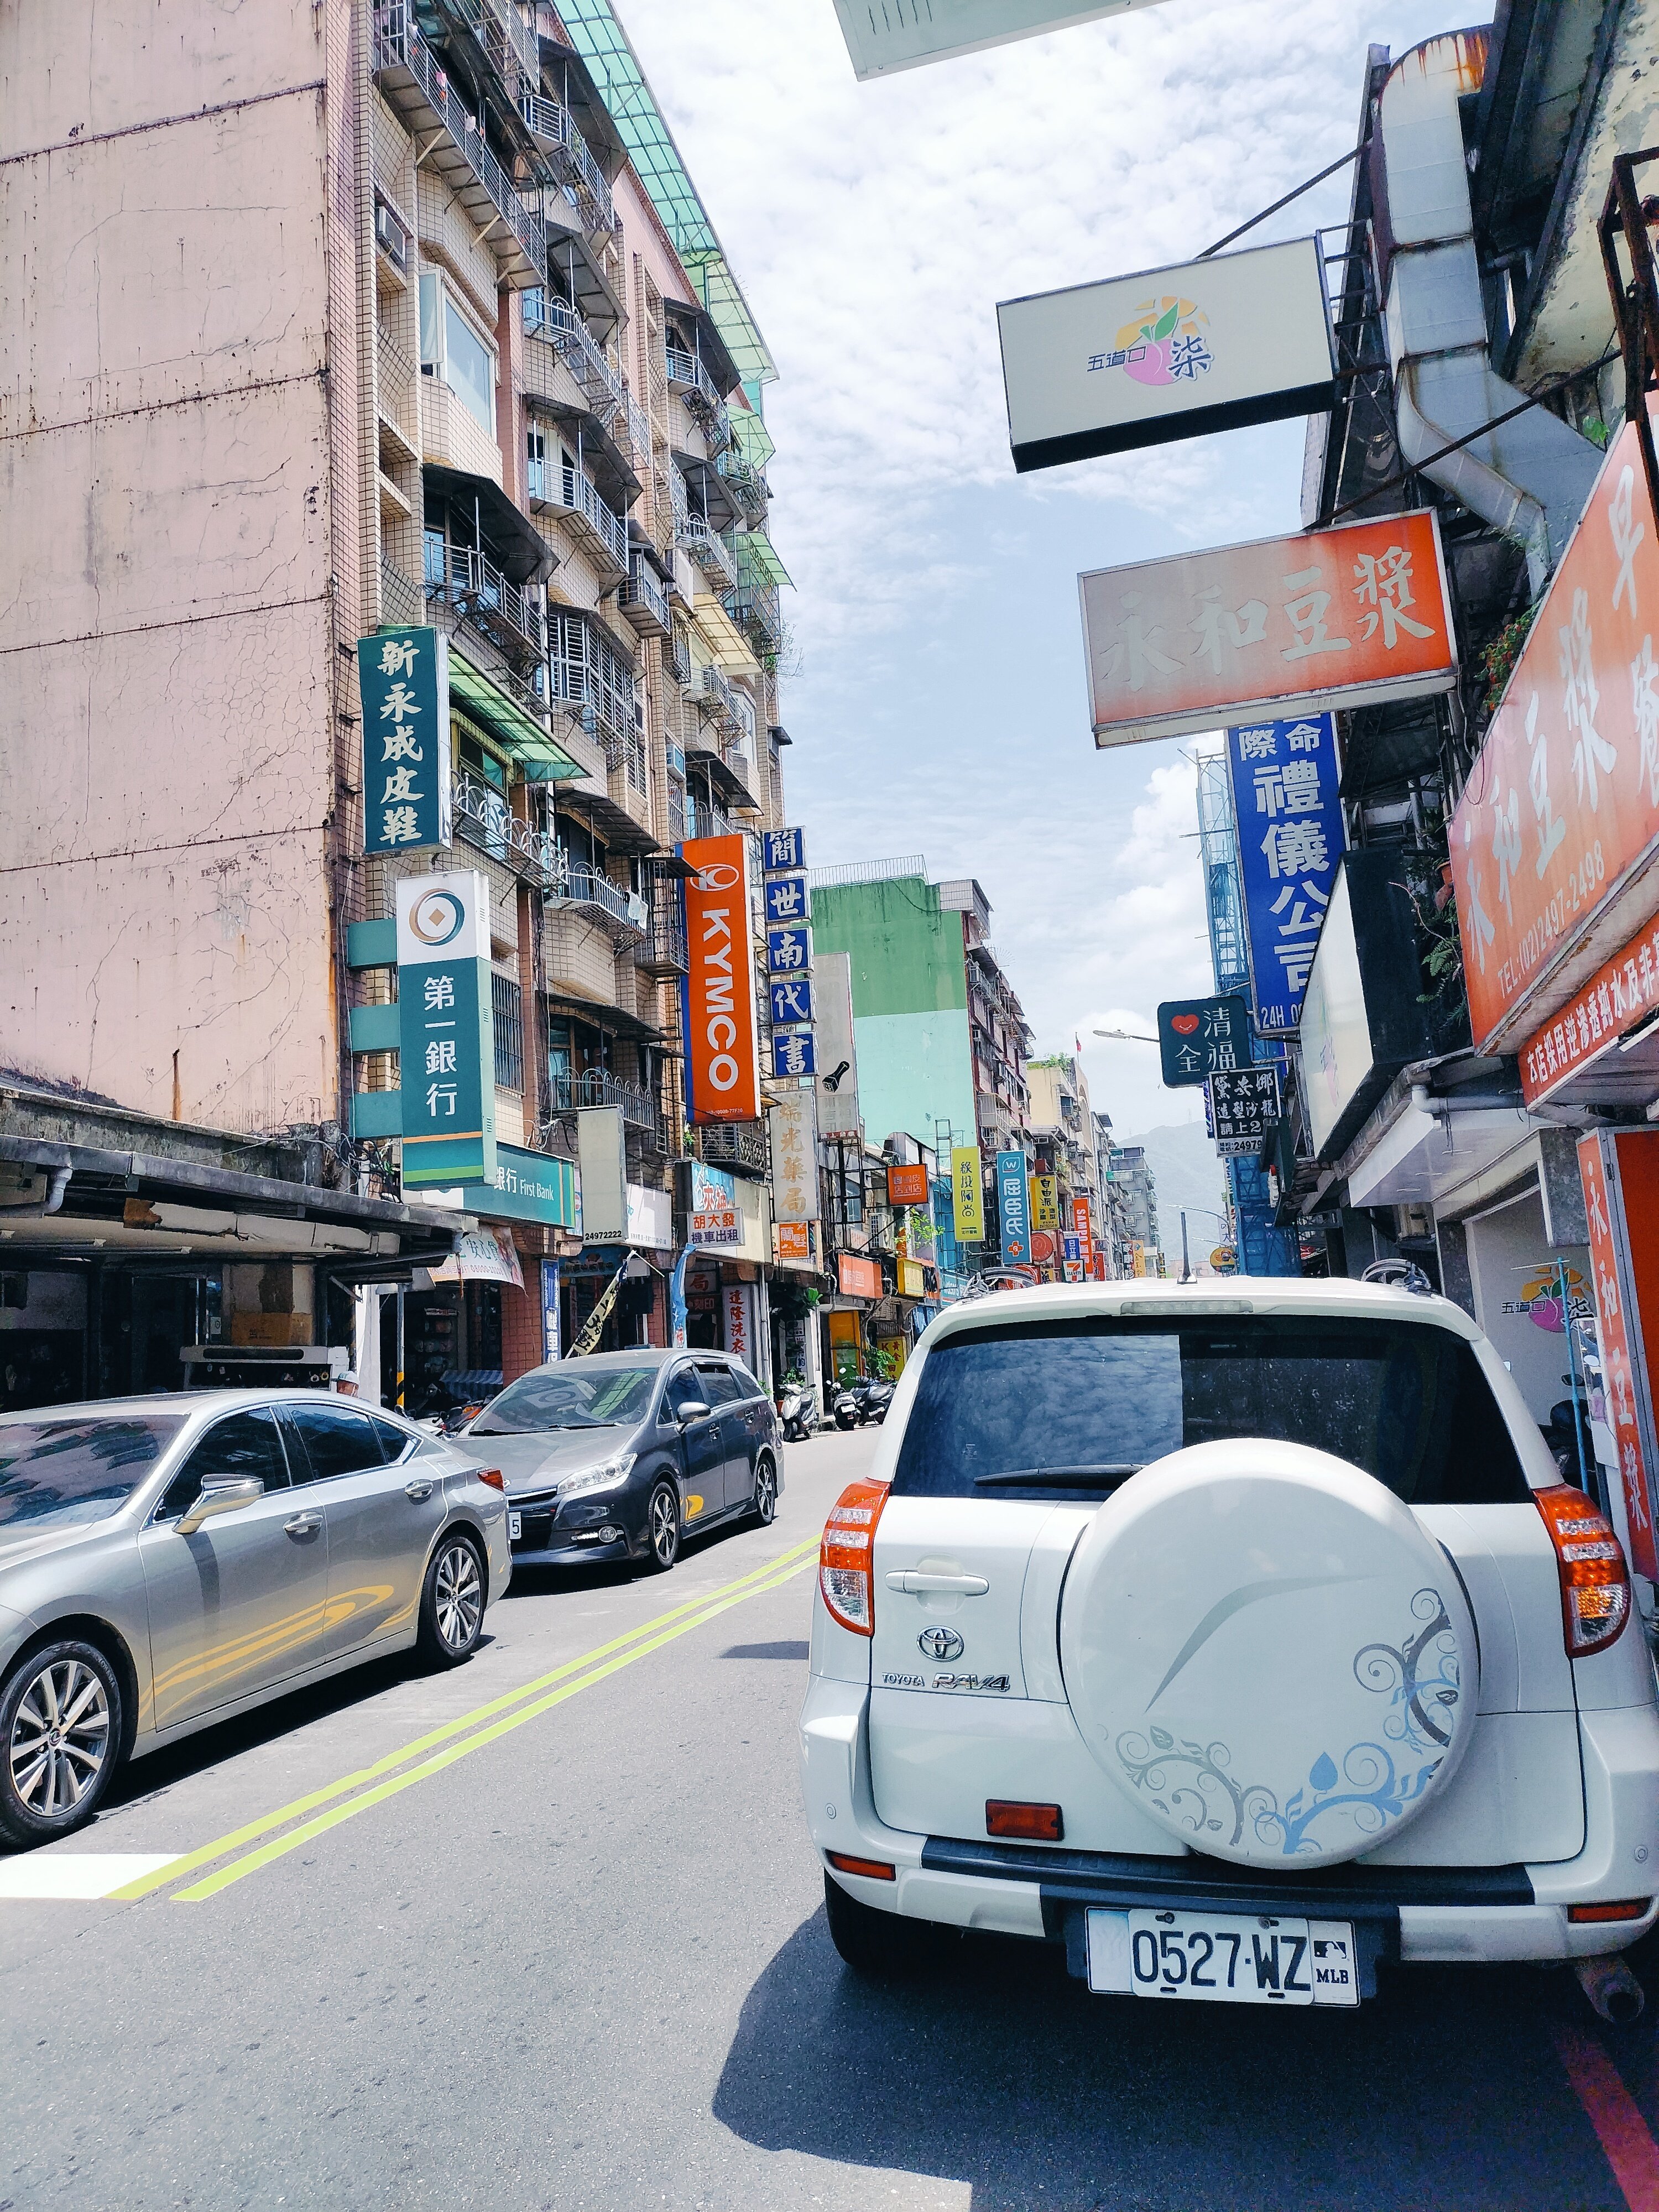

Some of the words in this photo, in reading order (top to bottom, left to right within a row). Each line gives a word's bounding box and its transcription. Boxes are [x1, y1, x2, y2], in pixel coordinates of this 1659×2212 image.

[1087, 346, 1147, 372] 五道口
[1168, 336, 1211, 378] 柒
[1100, 546, 1436, 692] 永和豆漿
[377, 639, 425, 846] 新永成皮鞋
[1238, 721, 1277, 762] 際
[1282, 714, 1322, 753] 命
[1465, 586, 1618, 976] 永和豆漿
[1252, 759, 1331, 993] 禮儀公司
[769, 830, 810, 1076] 簡世南代書
[702, 907, 739, 1092] KYMCO
[1261, 1004, 1285, 1029] 24H
[423, 975, 457, 1118] 第一銀行
[1214, 1072, 1274, 1100] 黛安娜
[1217, 1099, 1276, 1119] 造型沙龍
[779, 1098, 807, 1214] 瑞光藥局
[520, 1178, 535, 1197] First
[536, 1182, 554, 1201] Bank
[1003, 1178, 1024, 1235] 屈臣氏
[585, 1230, 622, 1241] 24972222
[691, 1229, 739, 1244] 機車出租
[693, 1212, 735, 1229] 胡大發
[1076, 1208, 1089, 1242] SAMPO
[690, 1274, 709, 1291] 局
[1501, 1301, 1546, 1314] 五道口
[881, 1672, 925, 1687] TOYOTA
[931, 1672, 1011, 1693] RAV4
[1316, 1968, 1349, 1984] MLB
